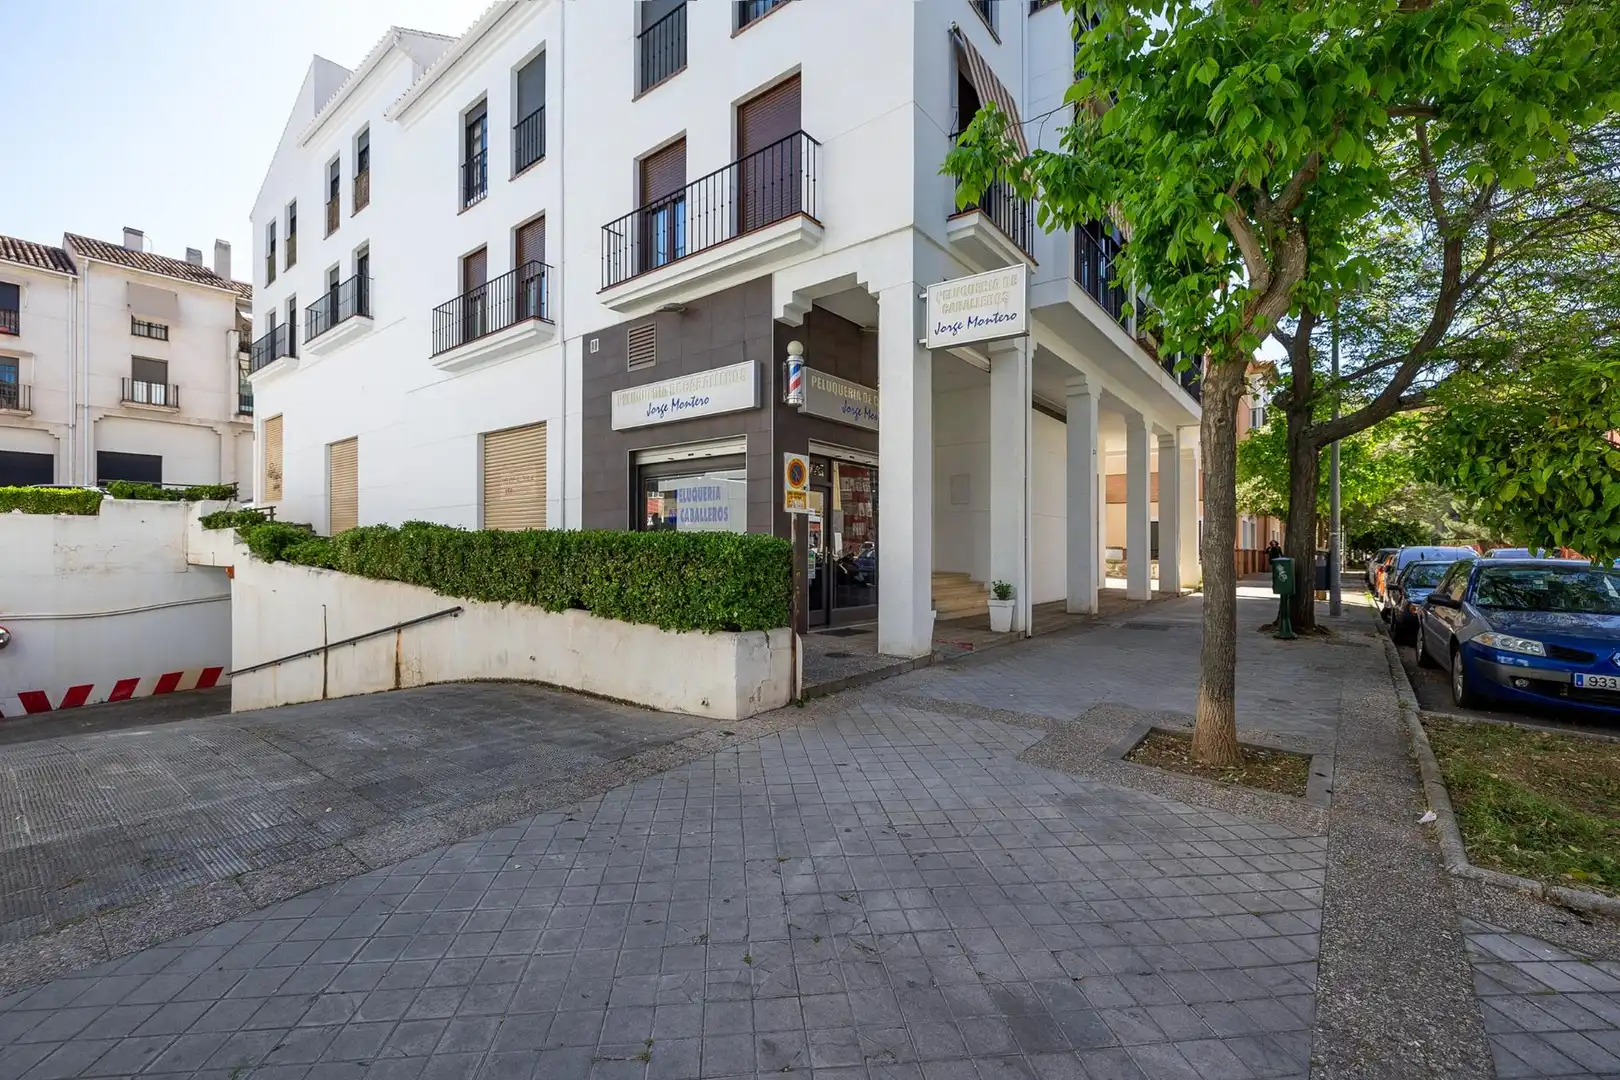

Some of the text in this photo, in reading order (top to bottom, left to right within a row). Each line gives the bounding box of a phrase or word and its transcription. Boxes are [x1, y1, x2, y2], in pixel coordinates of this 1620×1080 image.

[934, 312, 1017, 336] Jorge Montero
[811, 375, 861, 402] PELUQUERIA
[646, 395, 710, 418] Jorge Montero
[842, 400, 862, 421] Jorge
[680, 506, 729, 523] CABALLEROS
[1589, 676, 1617, 689] 933
